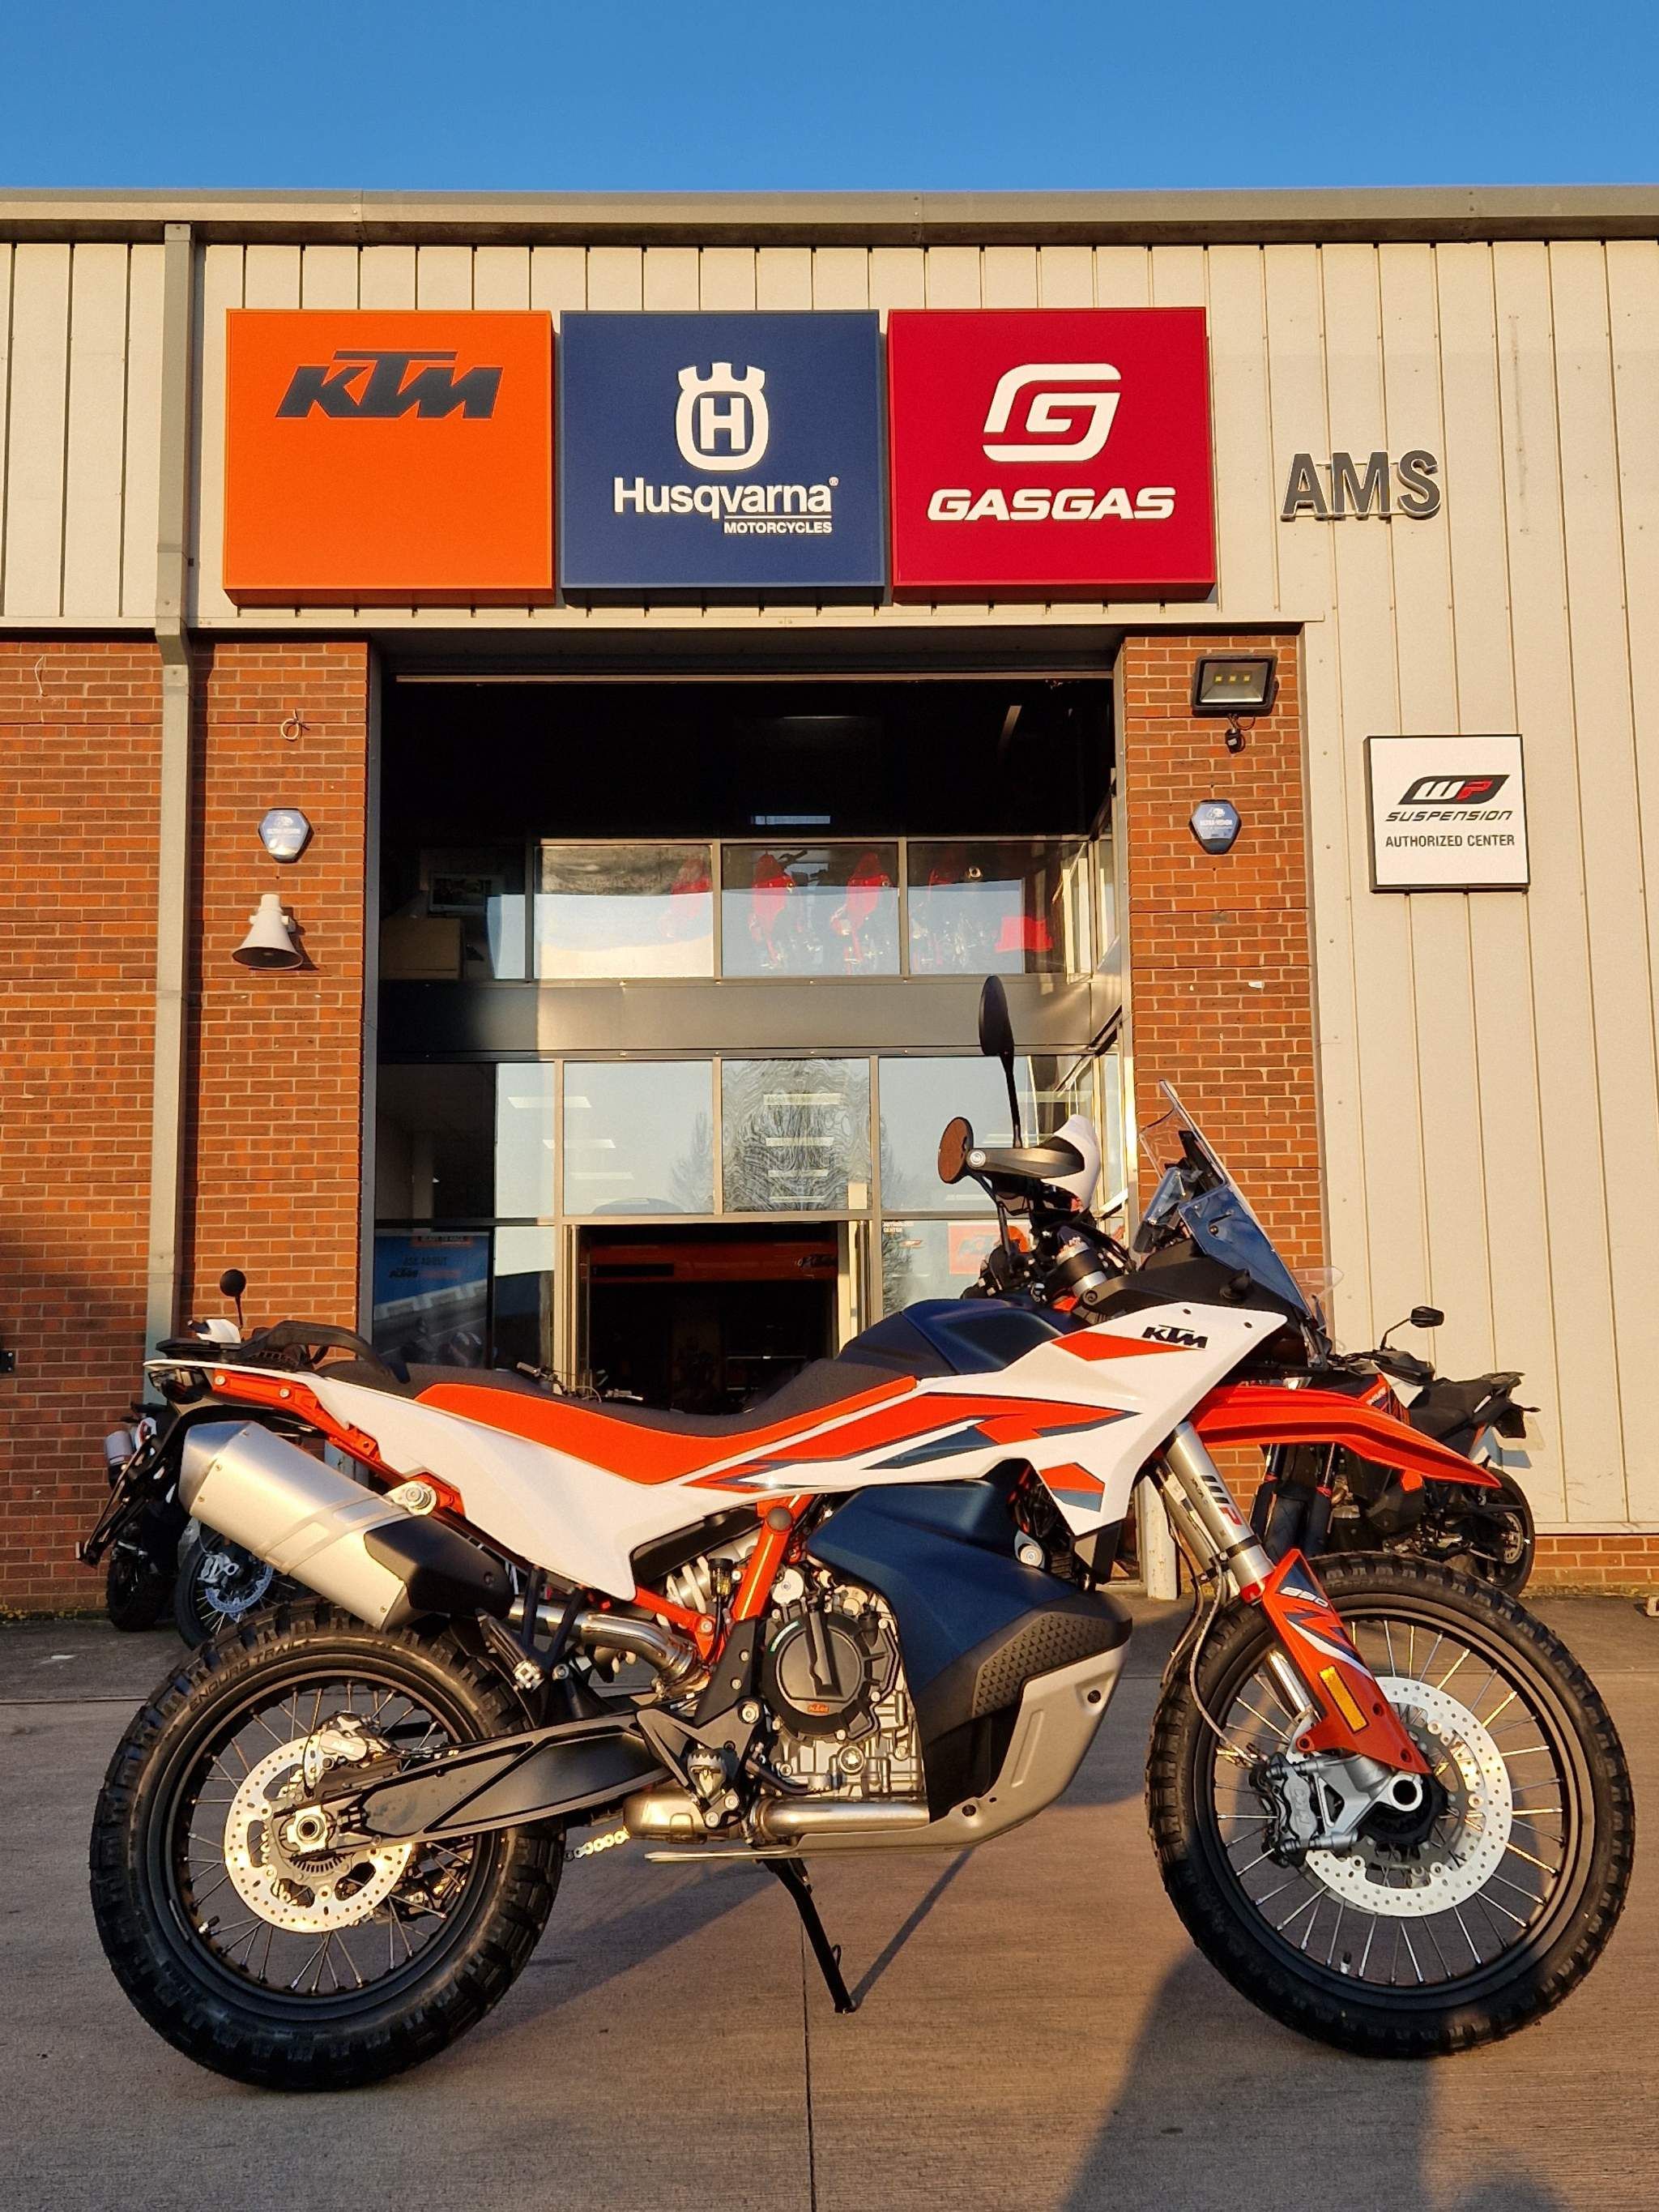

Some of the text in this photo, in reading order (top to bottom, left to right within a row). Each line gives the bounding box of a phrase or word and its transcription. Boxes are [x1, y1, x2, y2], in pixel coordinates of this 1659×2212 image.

[275, 349, 503, 419] KTM
[1280, 450, 1442, 520] AMS
[927, 486, 1176, 521] GASGAS
[723, 521, 832, 534] MOTORCYCLES
[1385, 810, 1512, 822] SUSPENSION
[1385, 835, 1515, 848] AUTHORIZED CENTER
[1141, 1324, 1208, 1349] KTM
[190, 1659, 250, 1711] ENDURO
